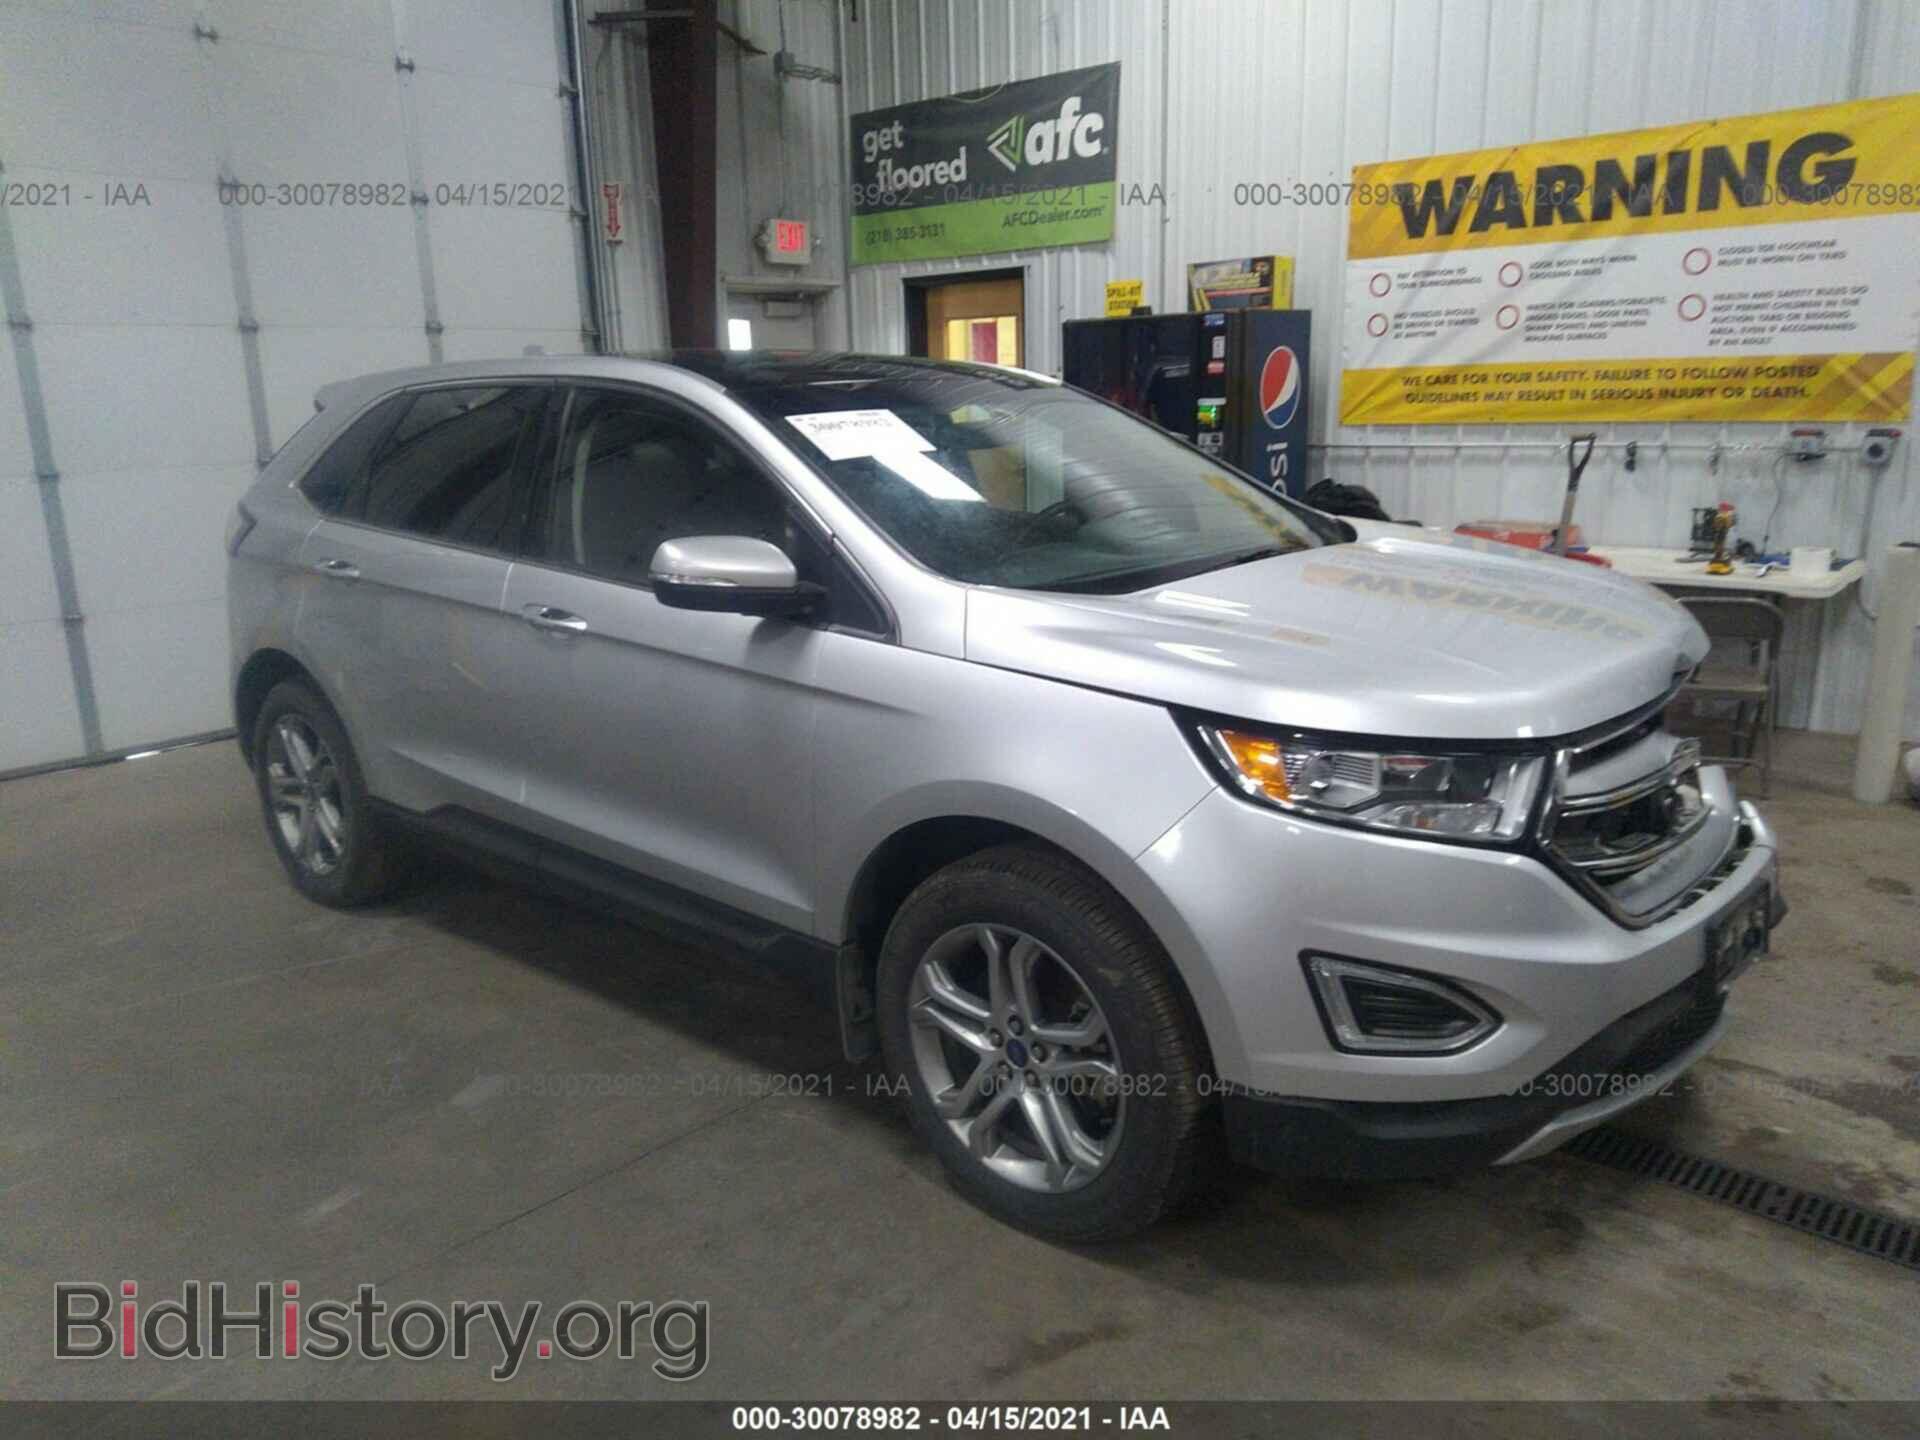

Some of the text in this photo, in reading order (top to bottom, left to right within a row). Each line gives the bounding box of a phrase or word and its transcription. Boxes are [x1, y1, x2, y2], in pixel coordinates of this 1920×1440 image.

[863, 120, 904, 163] get
[1024, 97, 1104, 165] afc
[876, 146, 967, 192] floored
[1391, 131, 1857, 240] WARNING
[777, 223, 806, 250] EXIT
[1404, 390, 1480, 404] GUIDELINES
[1482, 390, 1514, 402] MAY
[1518, 389, 1565, 401] RESULT
[1569, 388, 1586, 400] IN
[1591, 387, 1653, 400] SERIOUS
[1658, 386, 1717, 400] INJURY
[1722, 386, 1745, 399] OR
[1425, 372, 1458, 386] CARE
[1462, 371, 1489, 384] FOR
[1495, 370, 1533, 384] YOUR
[1593, 367, 1650, 381] FAILURE
[1657, 367, 1677, 380] TO
[1682, 366, 1749, 380] FOLLOW
[1753, 364, 1821, 379] POSTED
